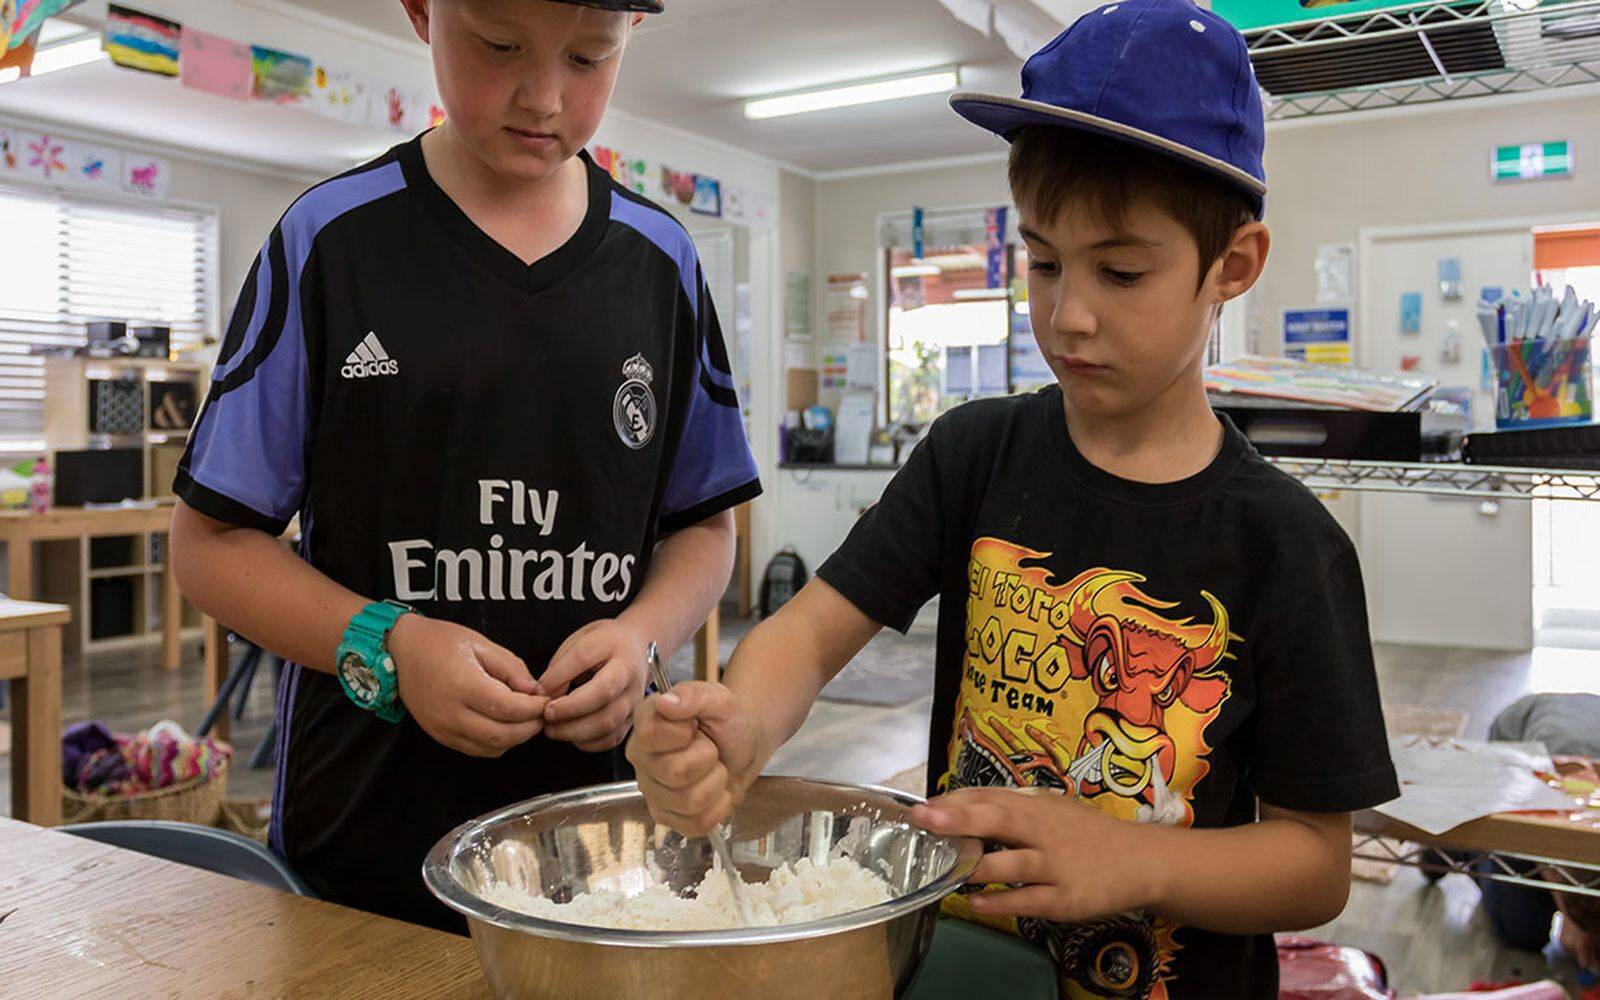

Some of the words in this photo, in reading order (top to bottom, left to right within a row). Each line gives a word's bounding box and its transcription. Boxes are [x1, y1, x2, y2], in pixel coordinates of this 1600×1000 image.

[341, 359, 399, 378] adidas
[478, 479, 559, 536] Fly
[387, 534, 635, 602] Emirates
